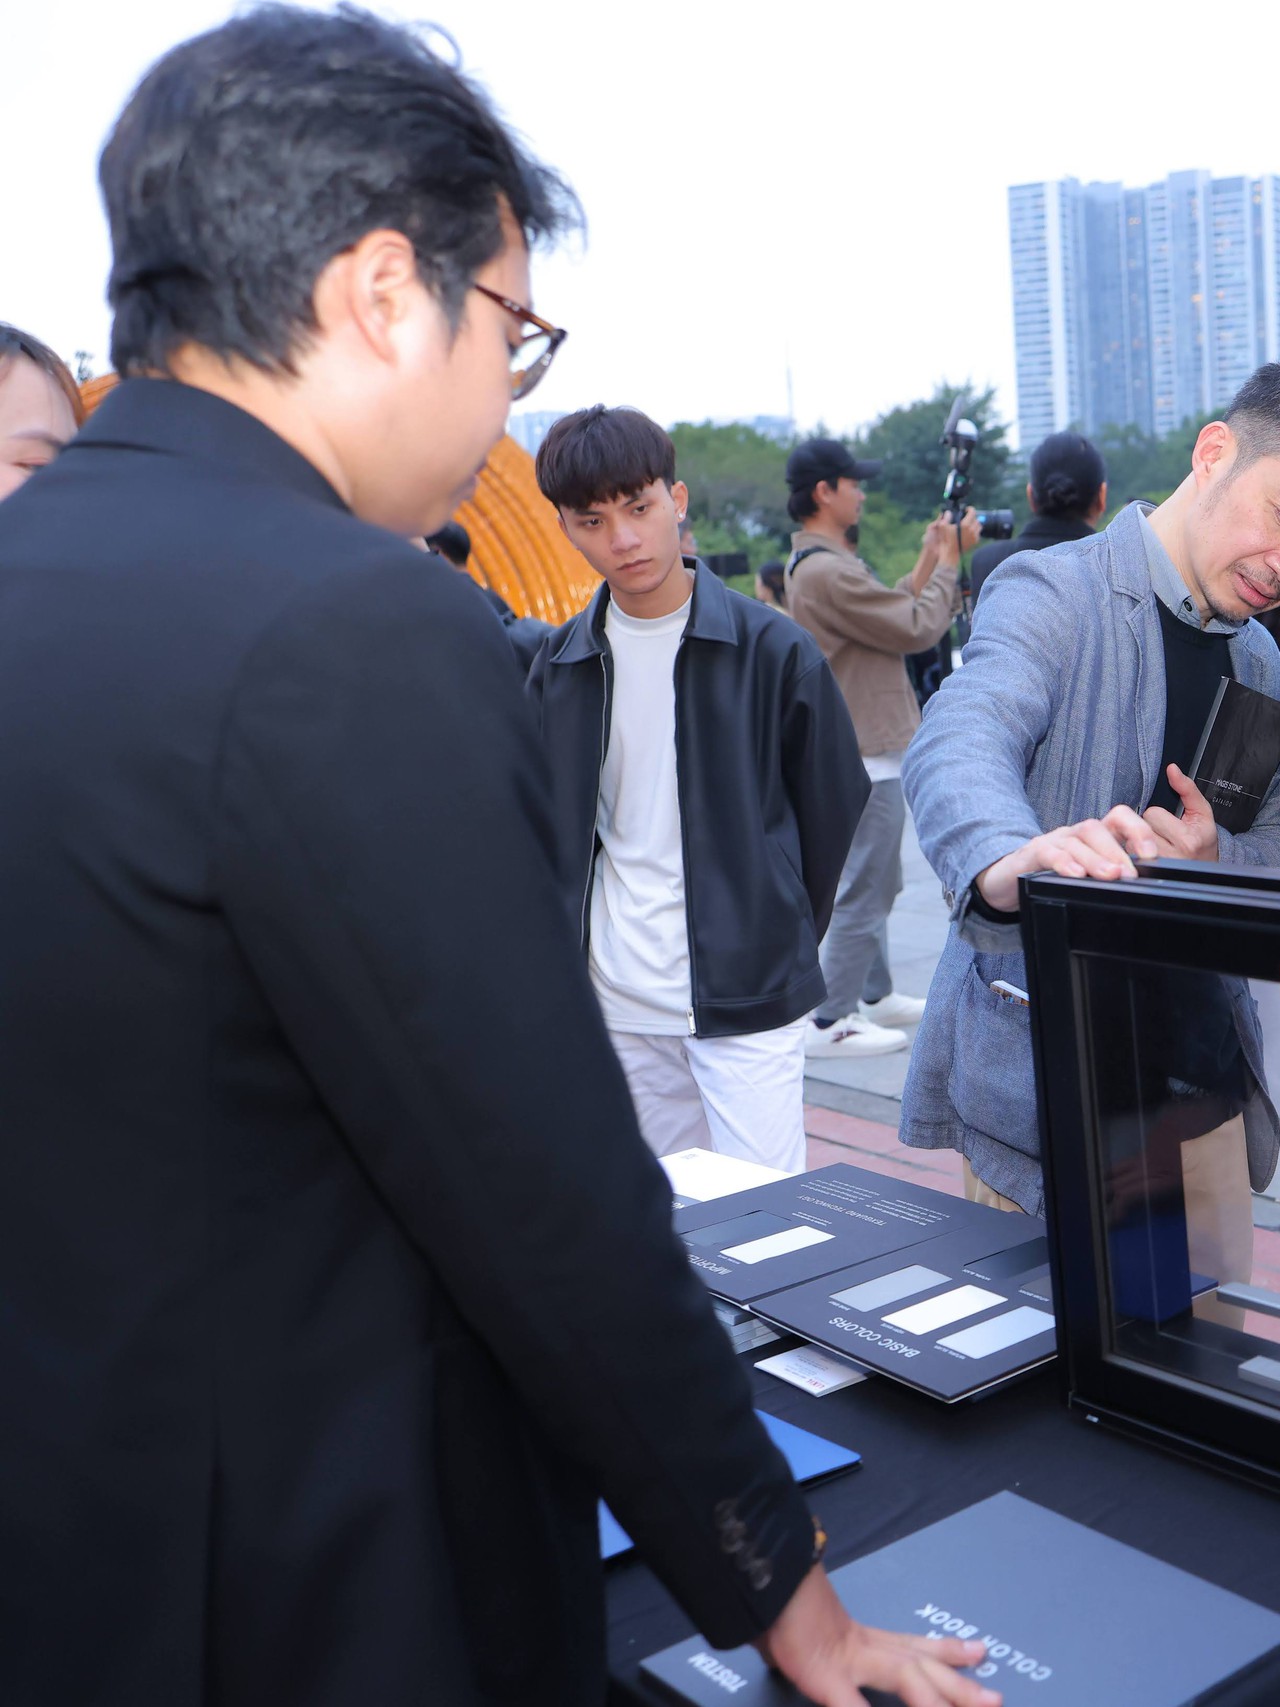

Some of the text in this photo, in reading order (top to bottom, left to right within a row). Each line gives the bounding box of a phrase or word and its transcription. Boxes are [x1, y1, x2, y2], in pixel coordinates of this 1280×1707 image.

[1227, 782, 1243, 793] STONE
[1212, 796, 1233, 808] CATALOG
[796, 1195, 846, 1213] TECHNOLOGY
[686, 1254, 733, 1276] IMPORTE
[828, 1315, 921, 1359] BASIC COLORS
[913, 1602, 979, 1640] BOOK
[686, 1650, 749, 1694] TOSTEM
